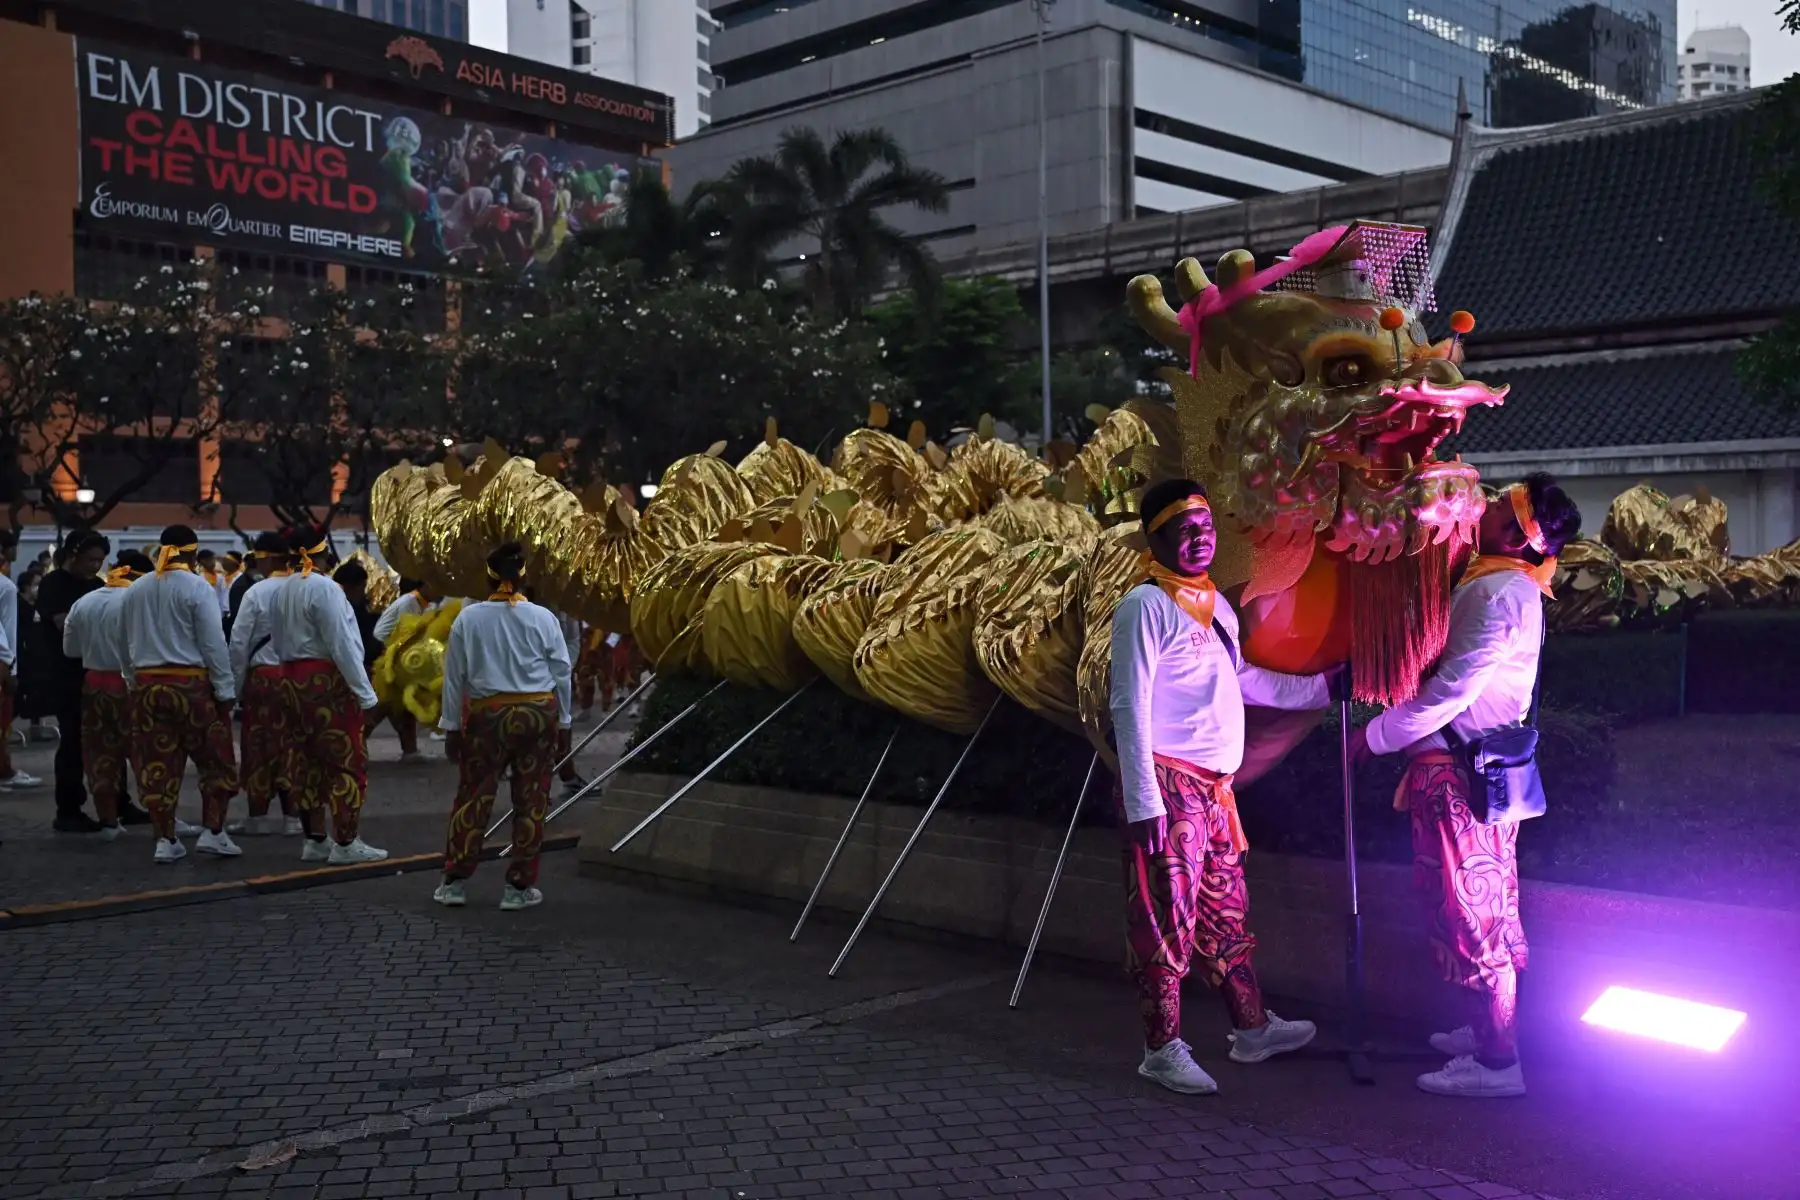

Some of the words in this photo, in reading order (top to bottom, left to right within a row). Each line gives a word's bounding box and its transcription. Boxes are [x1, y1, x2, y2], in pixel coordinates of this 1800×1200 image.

[87, 52, 162, 111] EM
[177, 72, 382, 152] DISTRICT
[455, 58, 505, 91] ASIA
[511, 73, 567, 105] HERB
[573, 91, 655, 124] ASSOCIATION
[90, 136, 194, 185] THE
[205, 159, 377, 214] WORLD
[124, 109, 348, 178] CALLING
[289, 225, 402, 257] EMSPHERE
